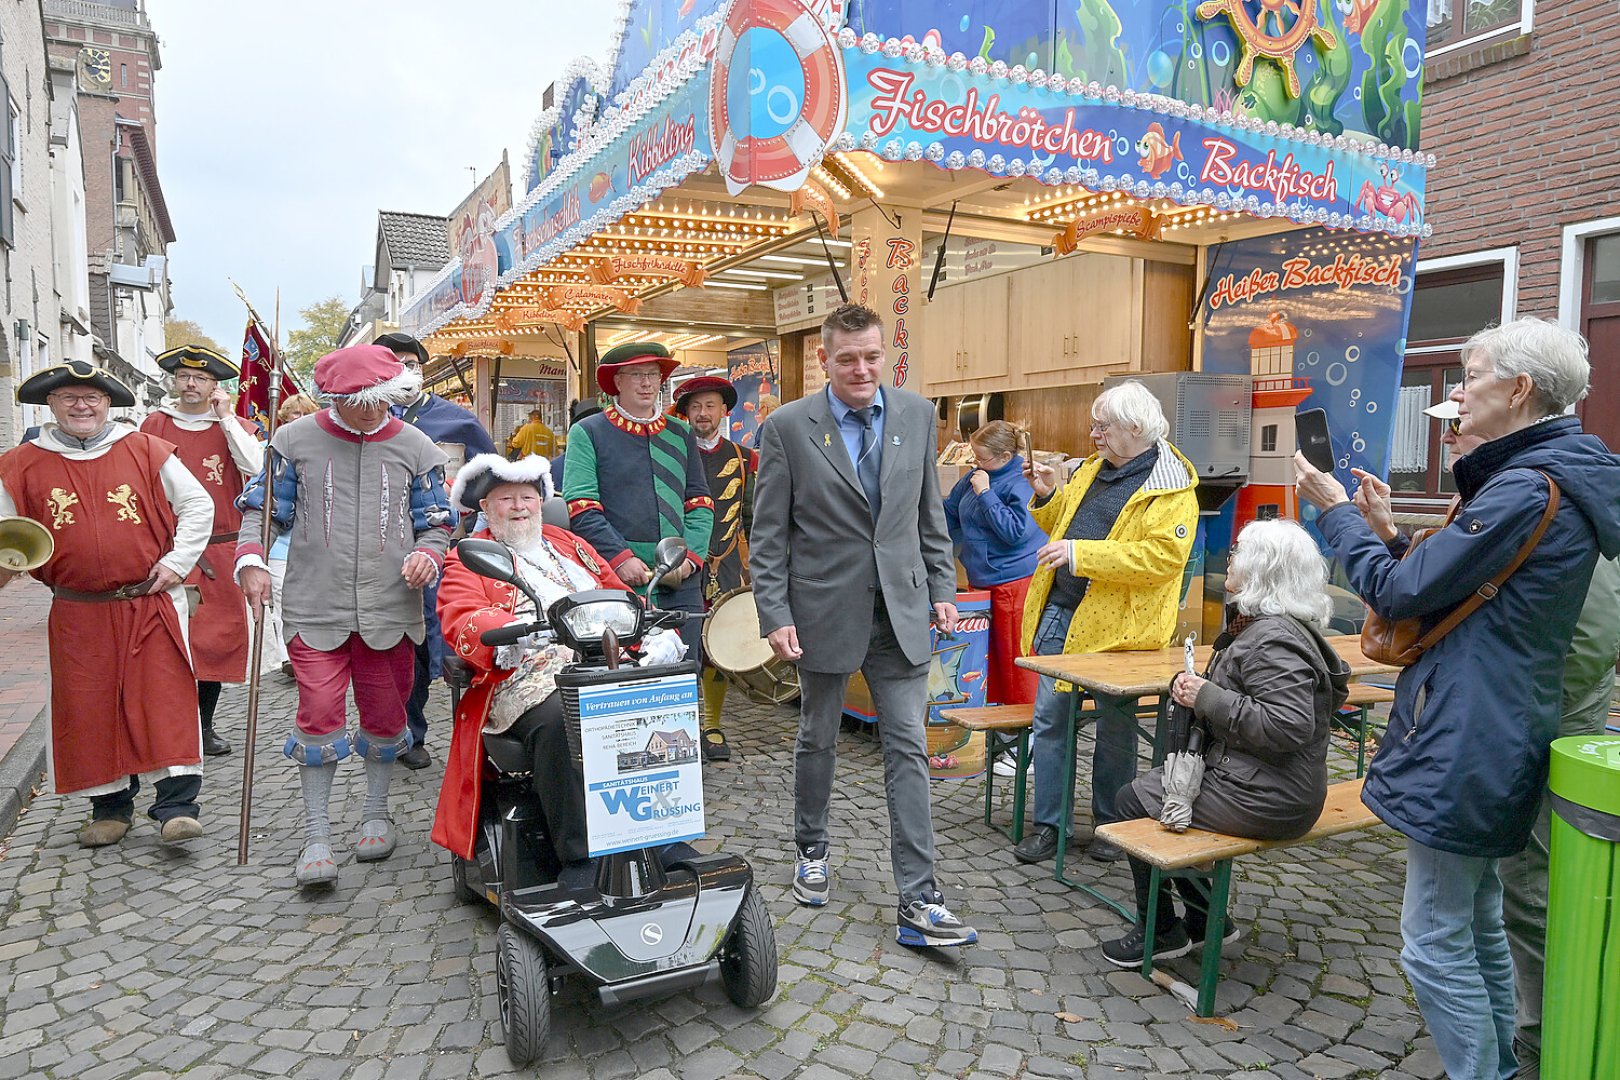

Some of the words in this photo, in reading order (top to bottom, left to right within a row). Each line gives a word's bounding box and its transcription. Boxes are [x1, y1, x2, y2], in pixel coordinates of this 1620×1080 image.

[867, 67, 1115, 164] Fischbrötchen
[627, 113, 695, 189] Kibbeling
[1200, 137, 1338, 203] Backfisch
[1076, 211, 1142, 238] Scampispieße
[1209, 267, 1280, 310] Heißer
[1281, 253, 1402, 289] Backfisch
[585, 699, 630, 711] Vertrauen
[631, 697, 648, 705] von
[649, 692, 680, 704] Anfang
[681, 691, 693, 699] an
[600, 781, 679, 815] WEINERT
[603, 777, 648, 789] SANITÄTSHAUS
[629, 796, 701, 822] GRÜSSING
